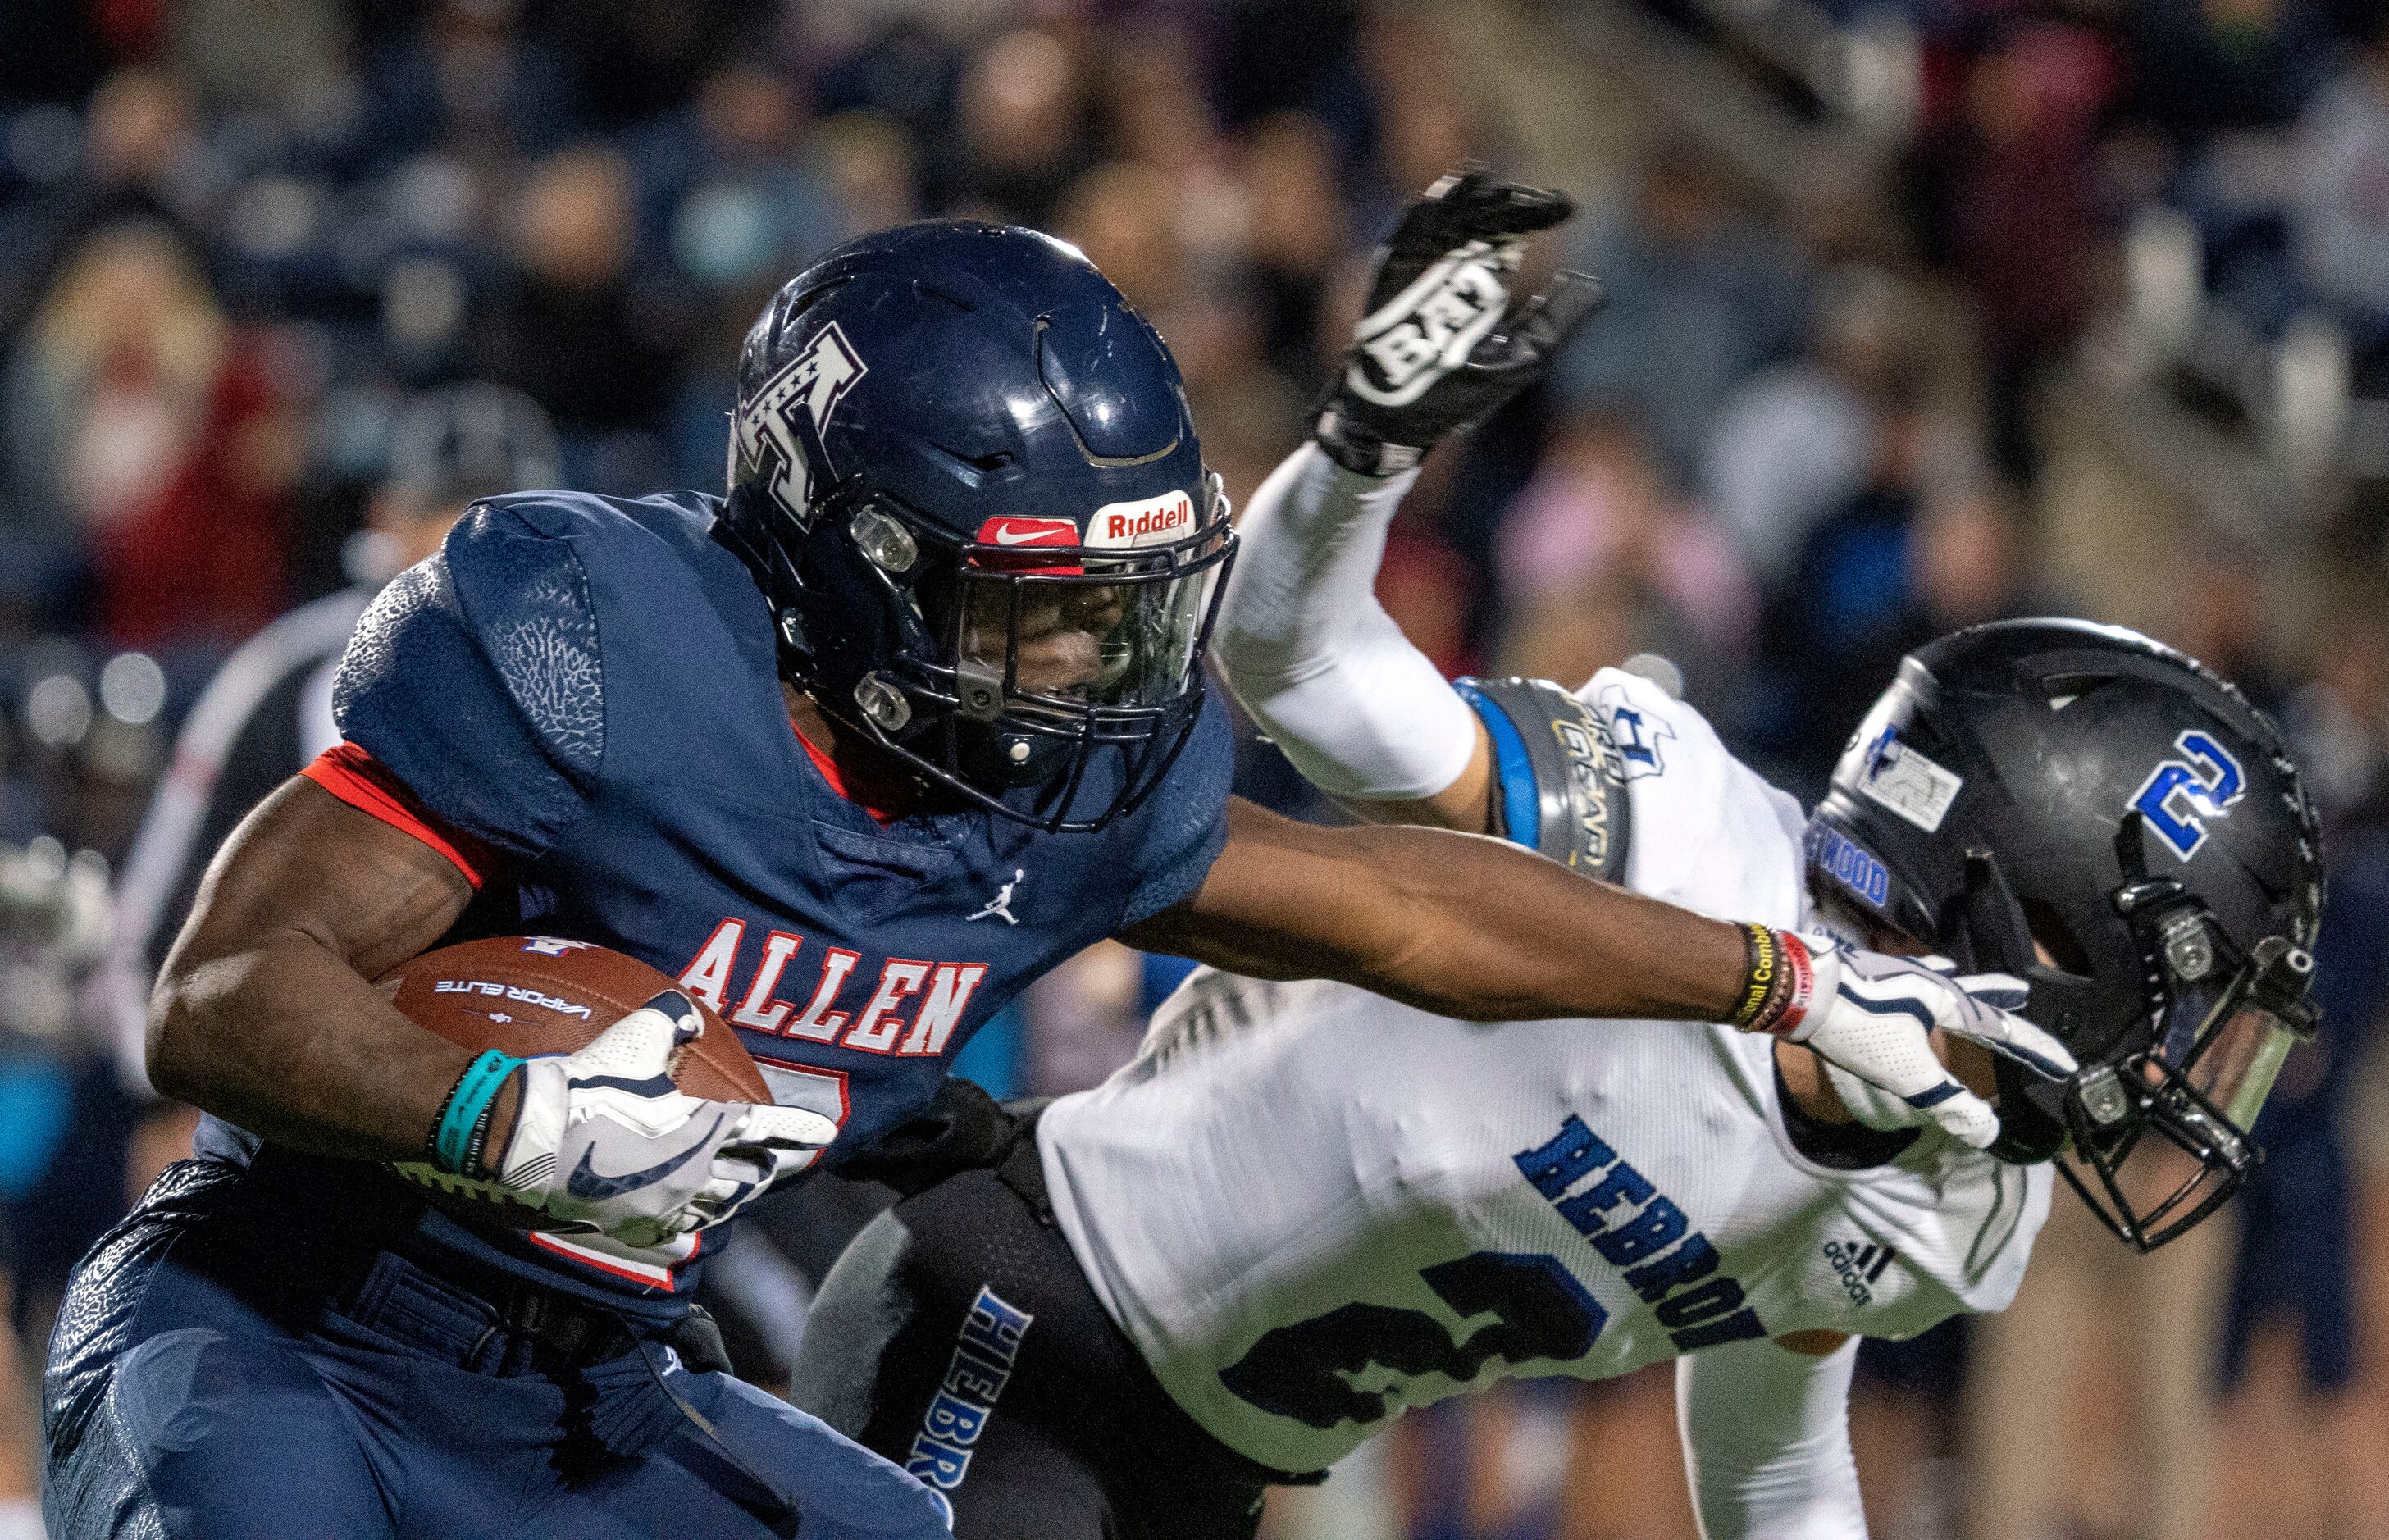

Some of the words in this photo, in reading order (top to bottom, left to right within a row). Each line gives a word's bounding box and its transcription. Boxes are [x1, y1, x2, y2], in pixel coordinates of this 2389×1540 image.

[1108, 500, 1188, 539] Riddell
[2124, 729, 2246, 863] 2
[435, 980, 506, 996] ELITE
[506, 986, 592, 1021] VAPOR
[677, 916, 990, 1058] ALLEN
[1823, 1240, 1872, 1308] adidas
